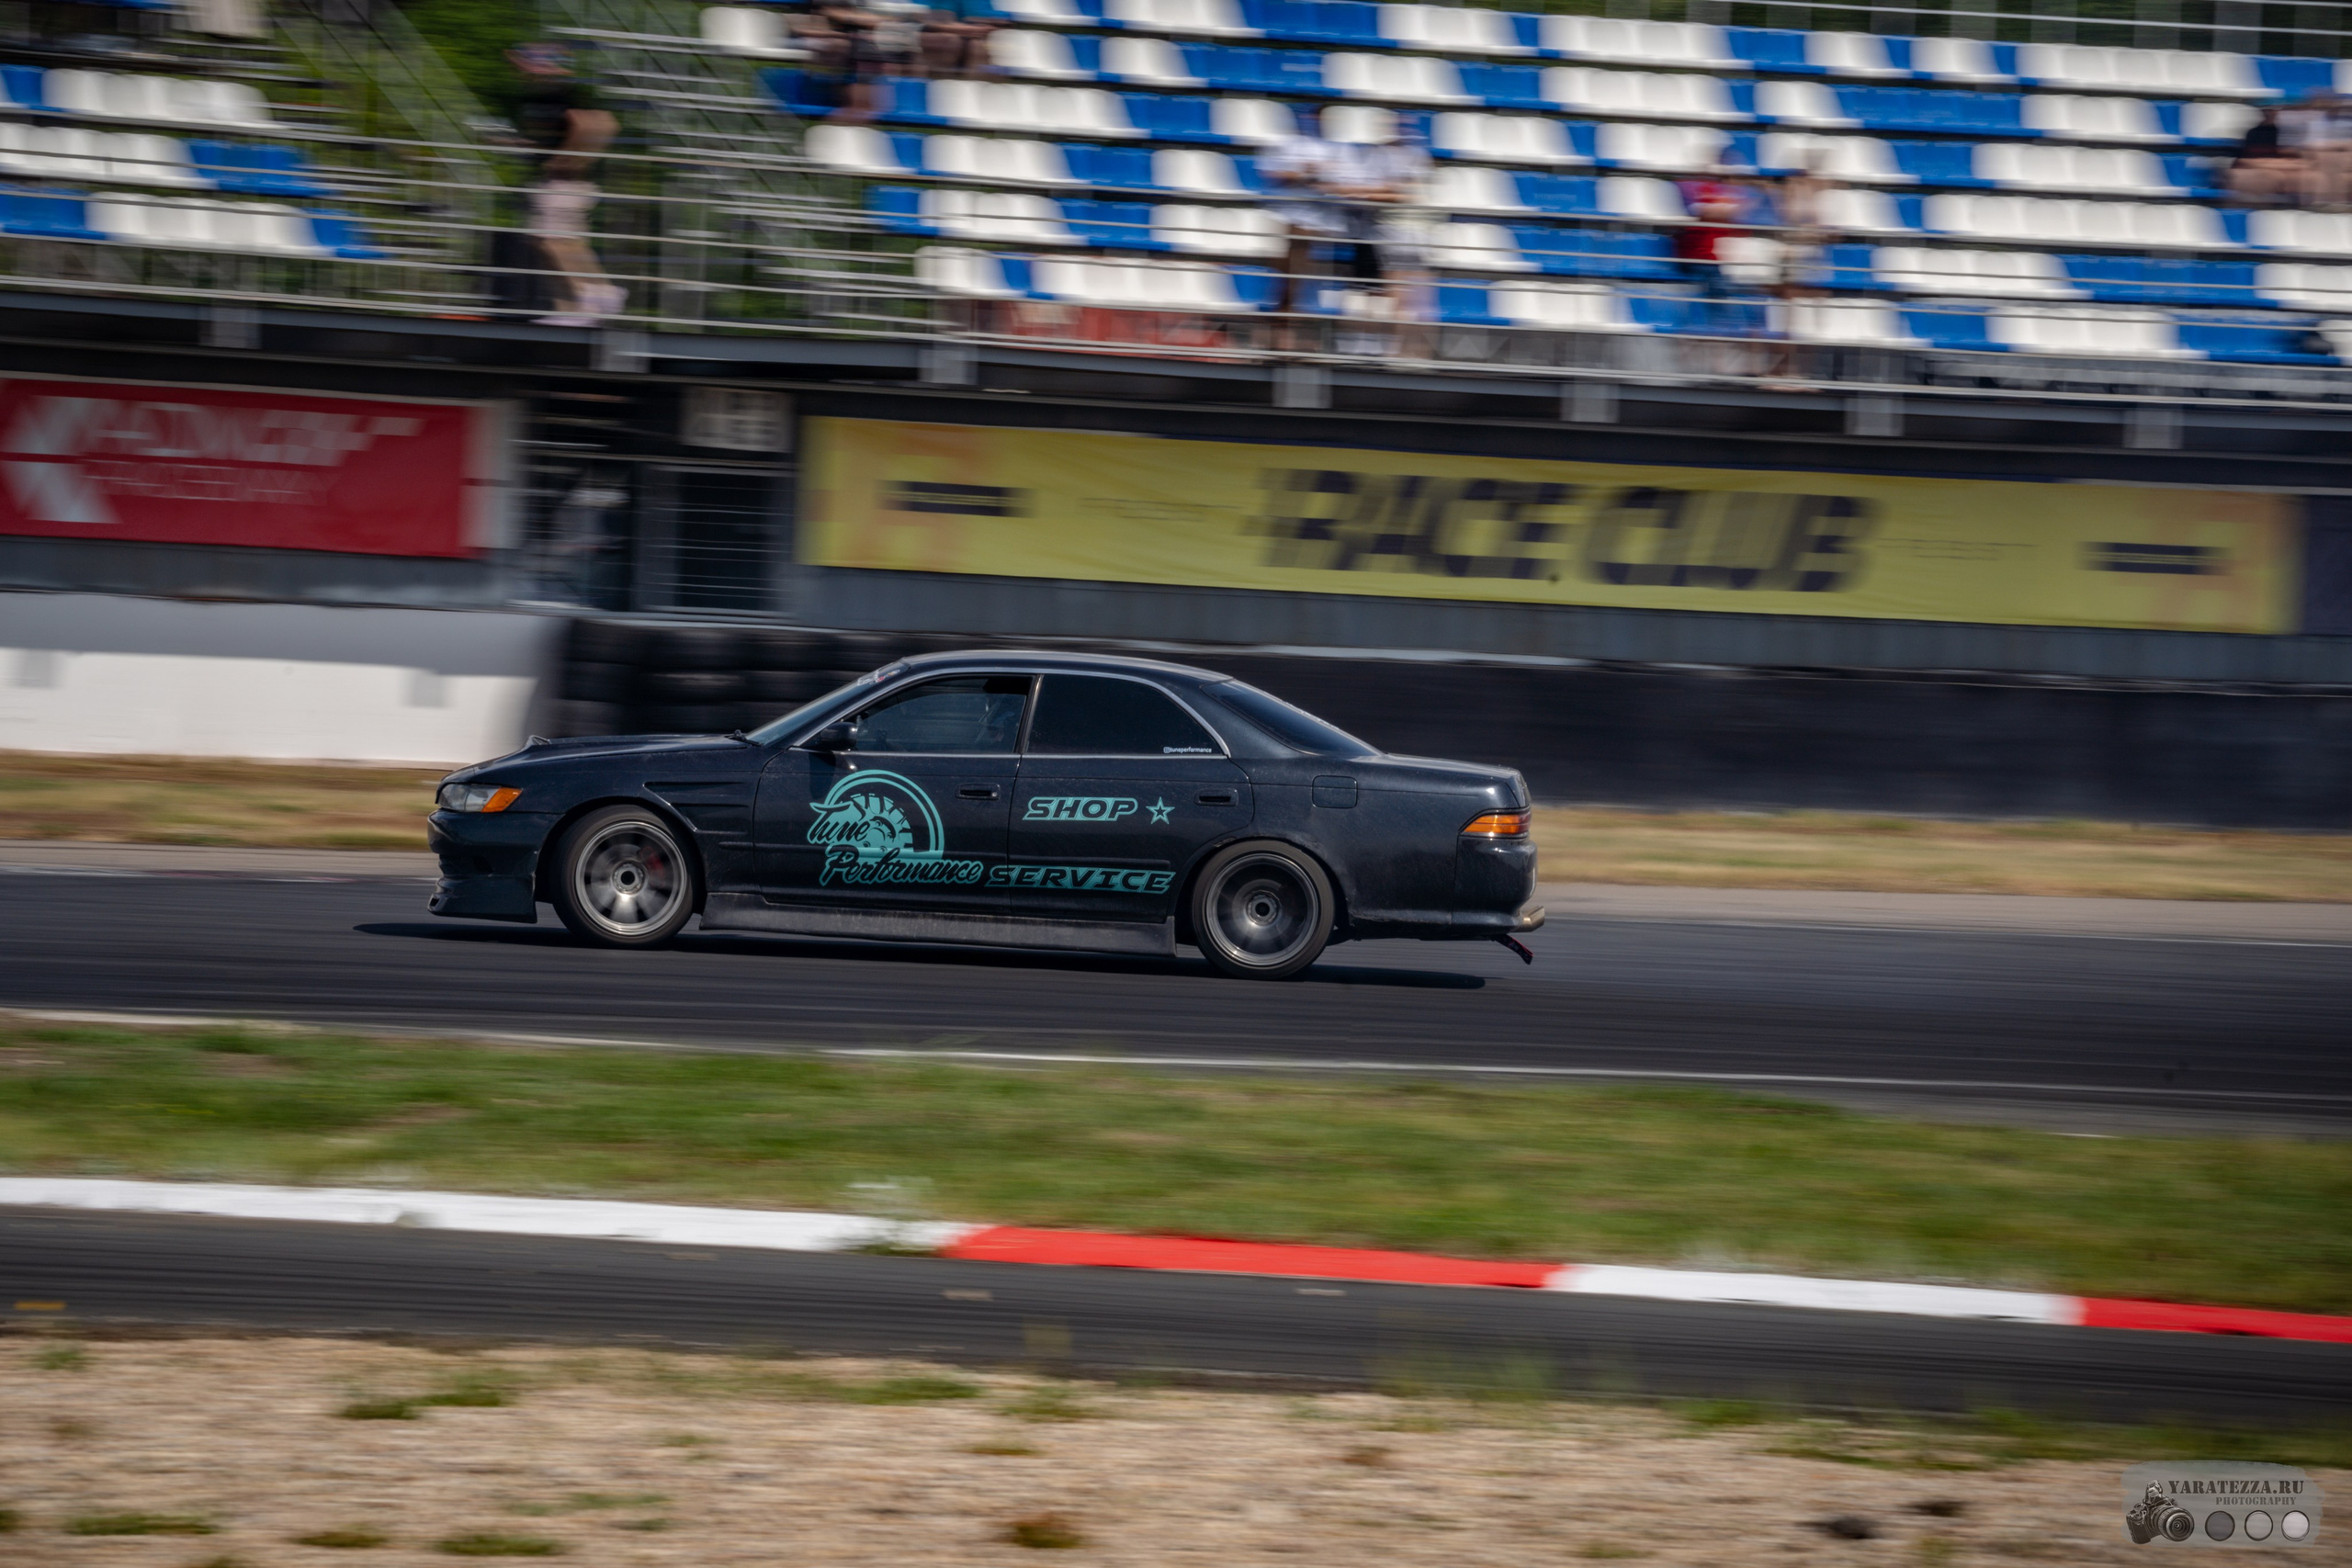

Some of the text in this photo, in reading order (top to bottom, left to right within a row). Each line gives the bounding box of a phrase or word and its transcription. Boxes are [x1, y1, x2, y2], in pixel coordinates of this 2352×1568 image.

[1255, 467, 1883, 592] RACE CLUB
[808, 802, 870, 844] Tune
[1023, 796, 1138, 821] SHOP
[820, 843, 984, 886] Performance
[984, 864, 1176, 894] SERVICE
